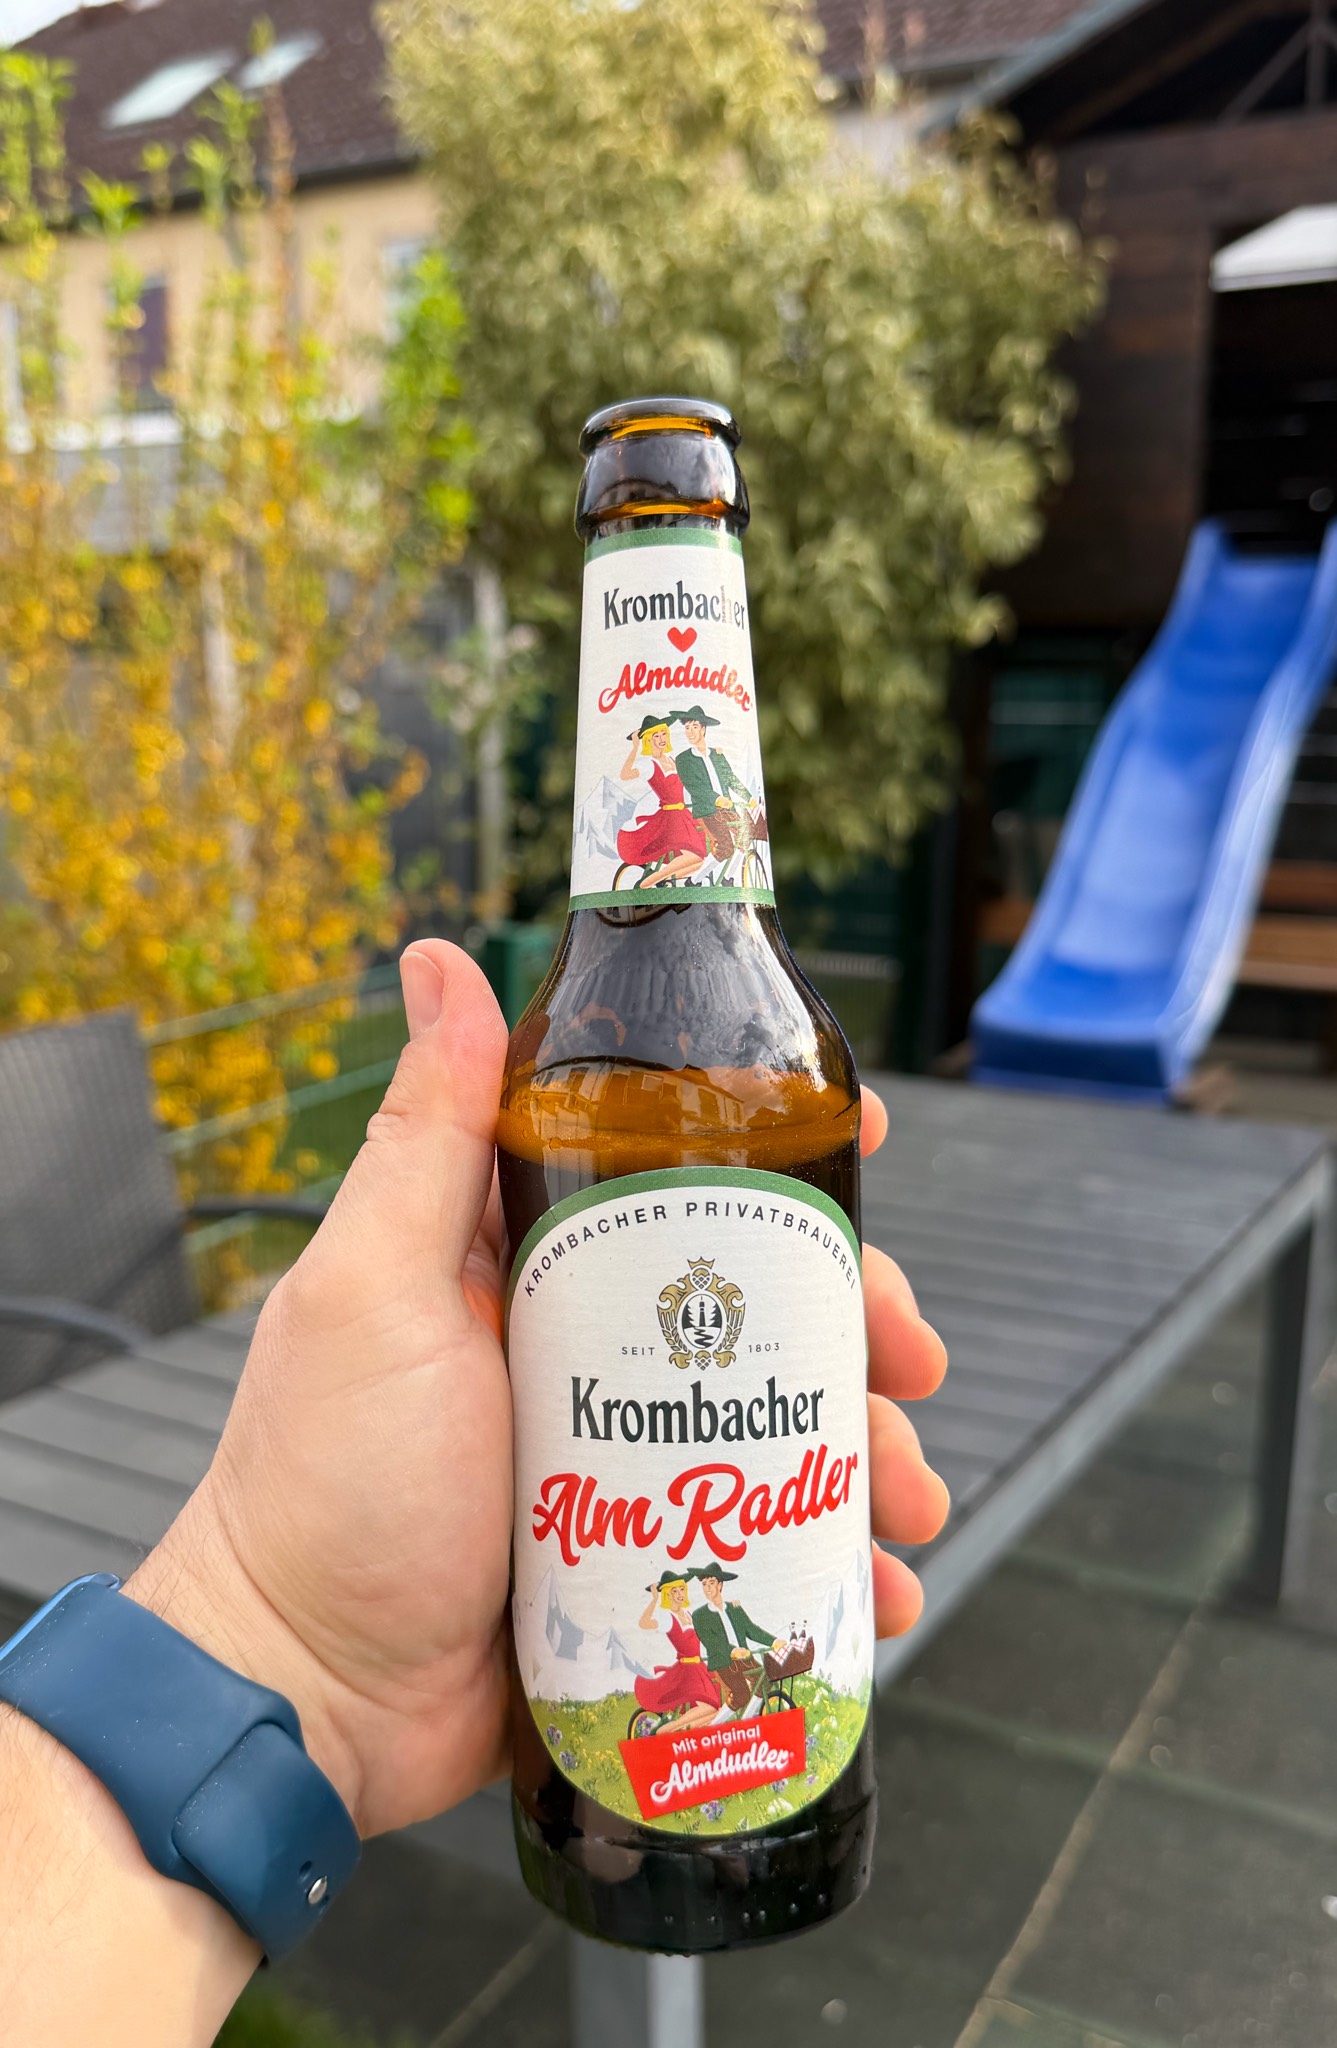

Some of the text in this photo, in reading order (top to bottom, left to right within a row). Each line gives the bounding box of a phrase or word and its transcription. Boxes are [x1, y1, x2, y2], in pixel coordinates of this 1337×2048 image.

[598, 656, 751, 714] Almdudler
[524, 1201, 857, 1298] KROMBACHER PRIVATBRAUEREI
[621, 1342, 781, 1356] SEIT 1803
[571, 1376, 824, 1443] Krombacher
[532, 1443, 859, 1566] Alm Radler
[672, 1724, 760, 1756] Mit original
[649, 1741, 790, 1803] Almdudler
